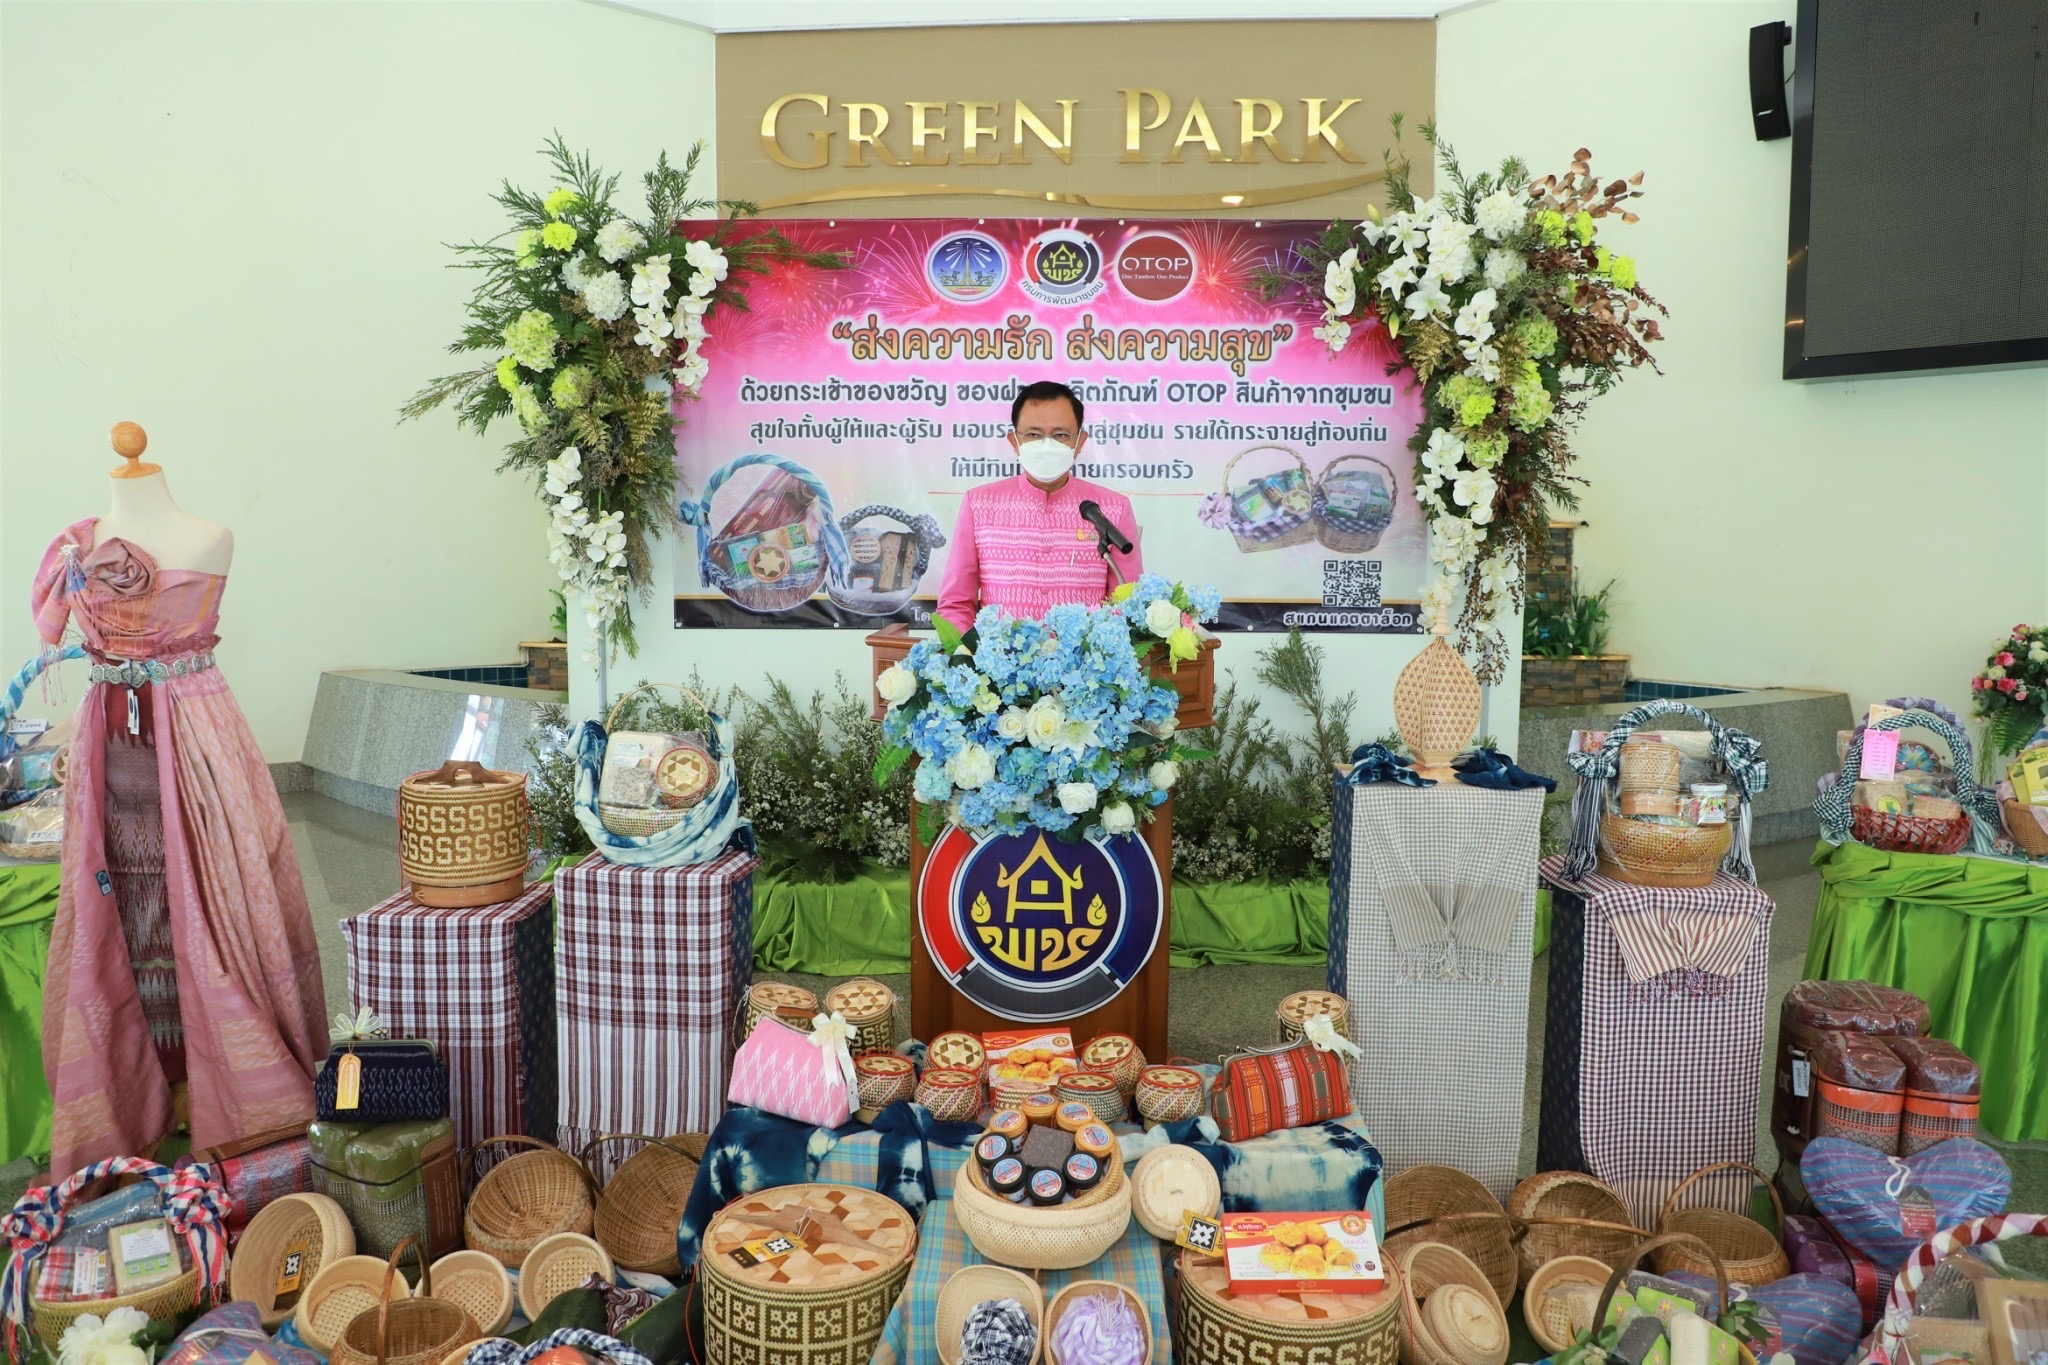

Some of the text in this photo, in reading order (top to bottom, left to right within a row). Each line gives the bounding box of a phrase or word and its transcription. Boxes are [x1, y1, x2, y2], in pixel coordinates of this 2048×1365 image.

[1122, 257, 1189, 271] OTOP
[1021, 279, 1104, 305] กรมการพัฒนาชุมชน
[741, 378, 947, 406] ด้วยกระเช้าของขวัญ
[1068, 378, 1157, 402] ลิตภัณฑ์
[1167, 383, 1226, 403] OTOP
[1236, 379, 1392, 410] สินค้าจากชุมชน
[750, 414, 942, 444] สุขใจทั้งผู้ให้และผู้รับ
[1174, 417, 1387, 447] รายได้กระจายสู่ท้องถิ่น
